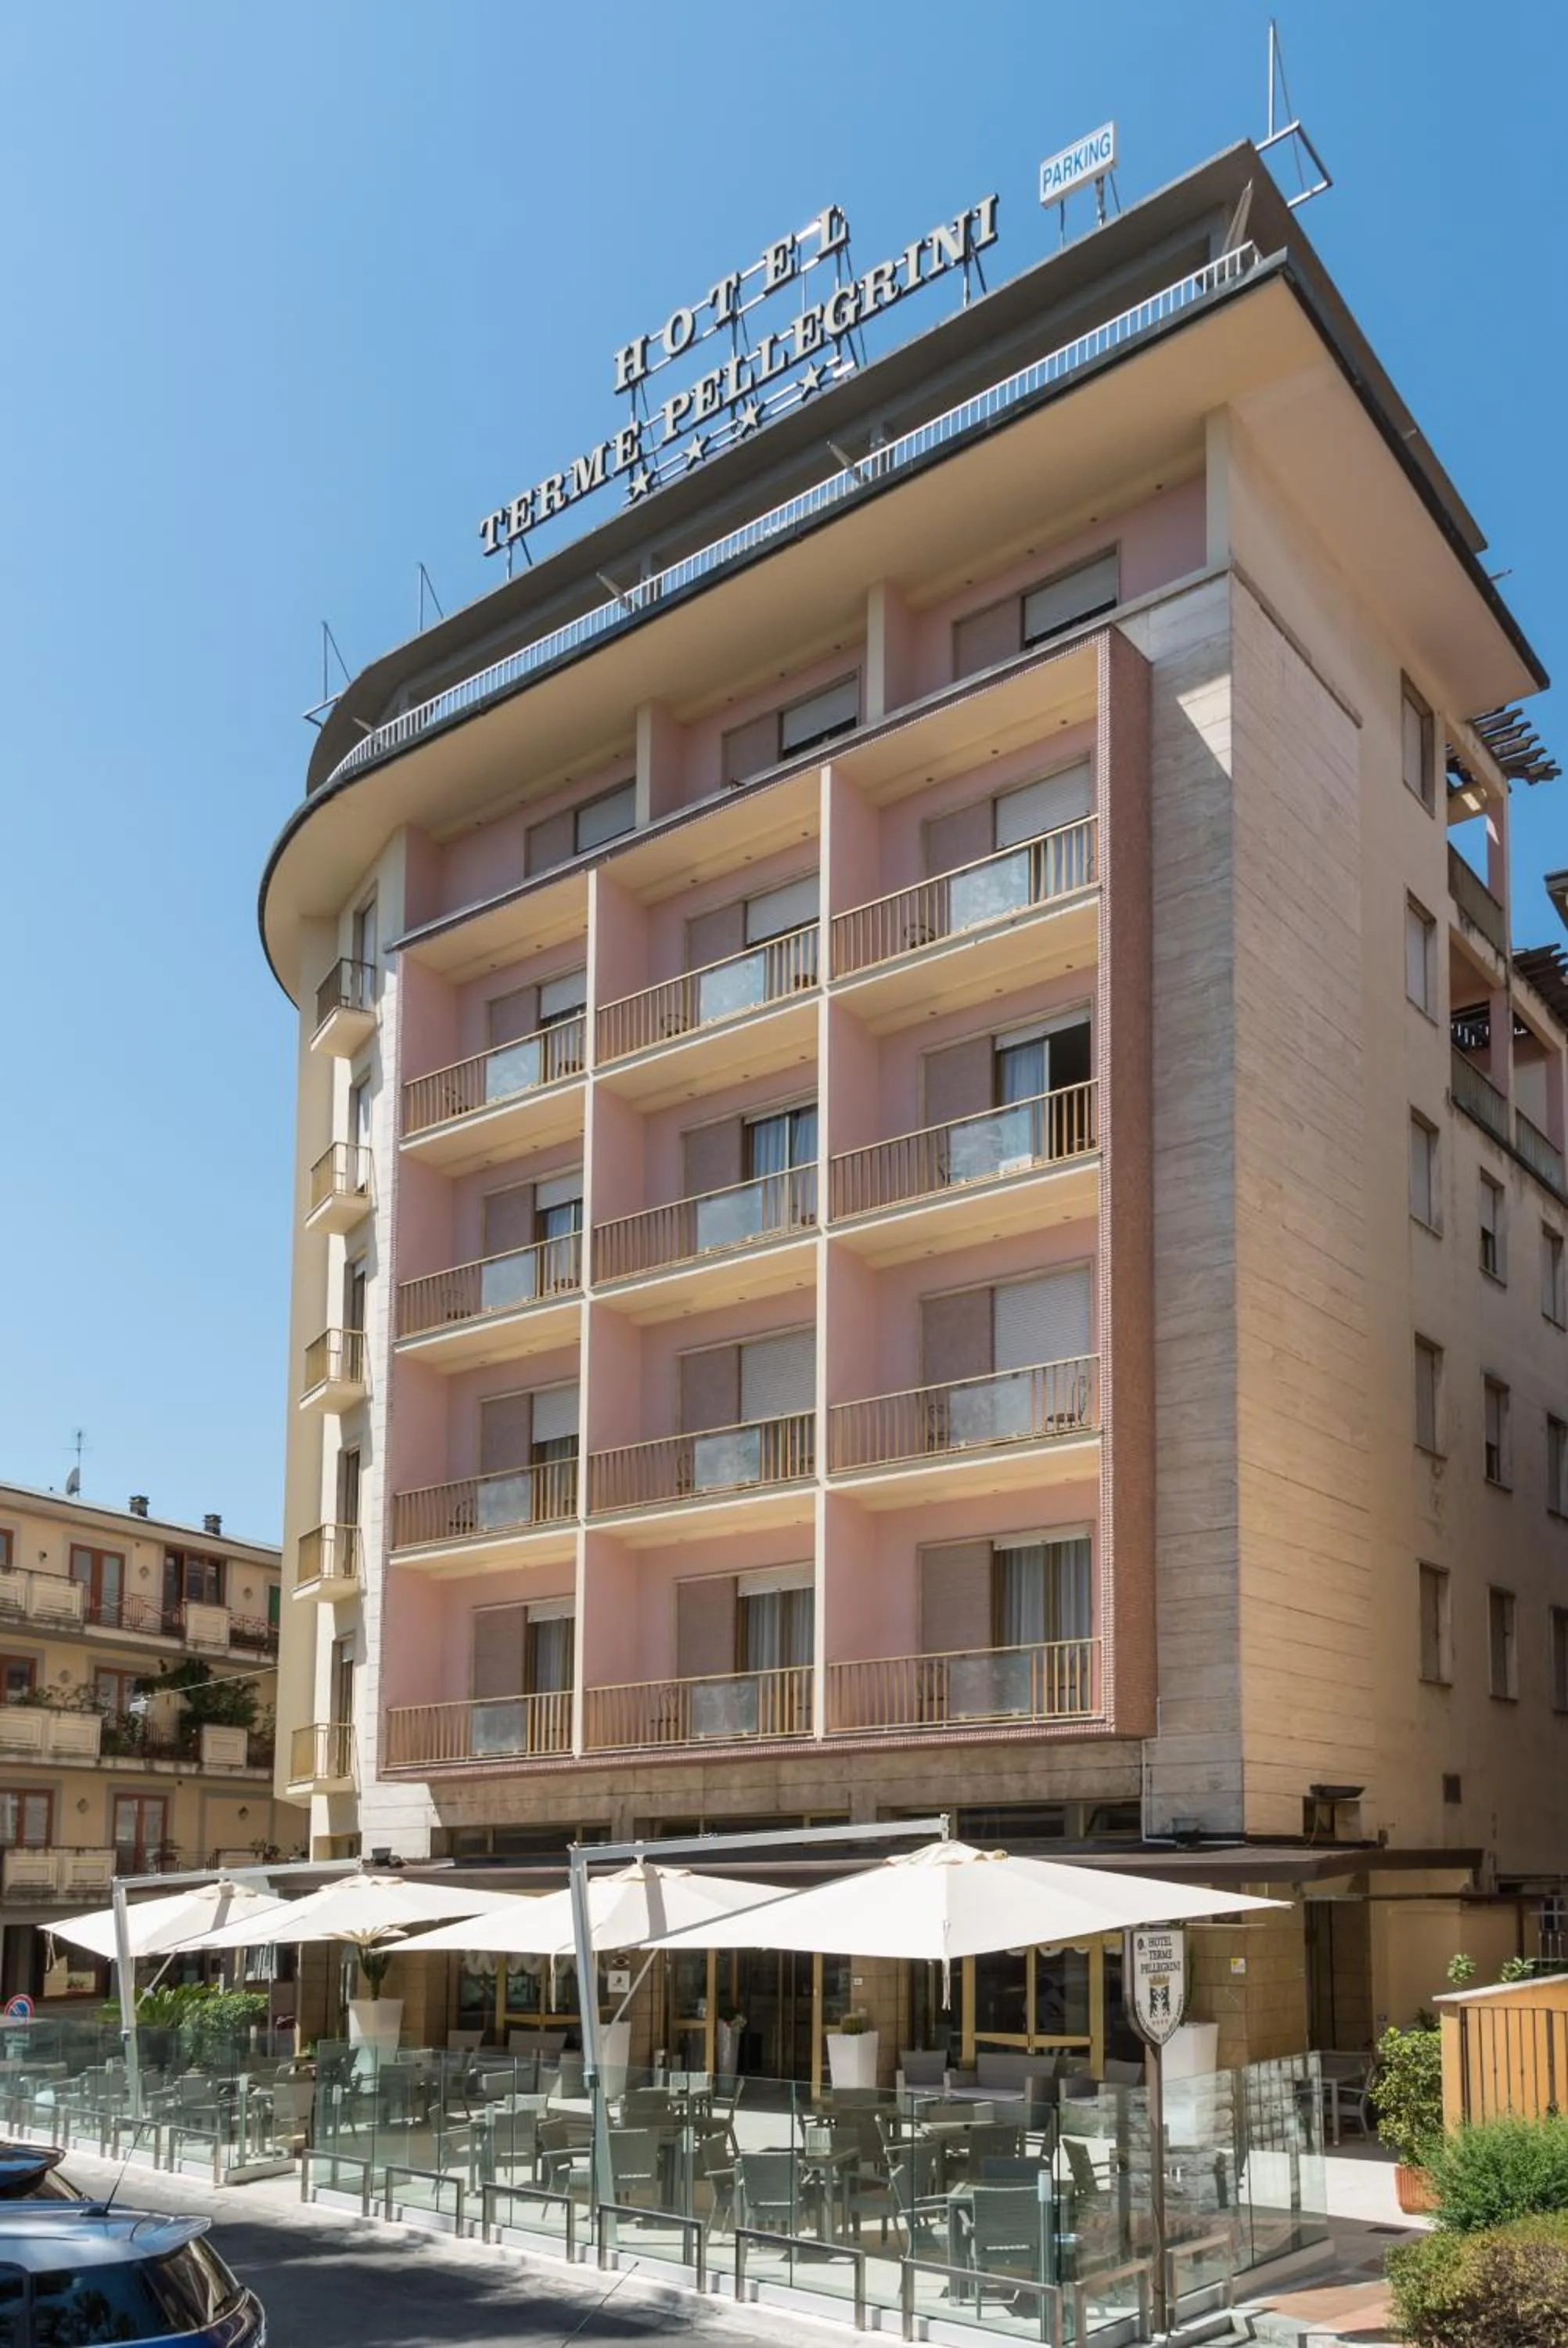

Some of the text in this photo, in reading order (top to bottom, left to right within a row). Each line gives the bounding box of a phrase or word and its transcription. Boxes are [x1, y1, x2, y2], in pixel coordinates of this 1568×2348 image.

[1043, 131, 1111, 193] PARKING
[613, 203, 850, 394] HOTEL
[479, 193, 999, 556] TERME PELLEGRINI
[1148, 1936, 1172, 1947] HOTEL
[1149, 1949, 1172, 1960] TERME
[1140, 1961, 1181, 1974] PELLEGRINI
